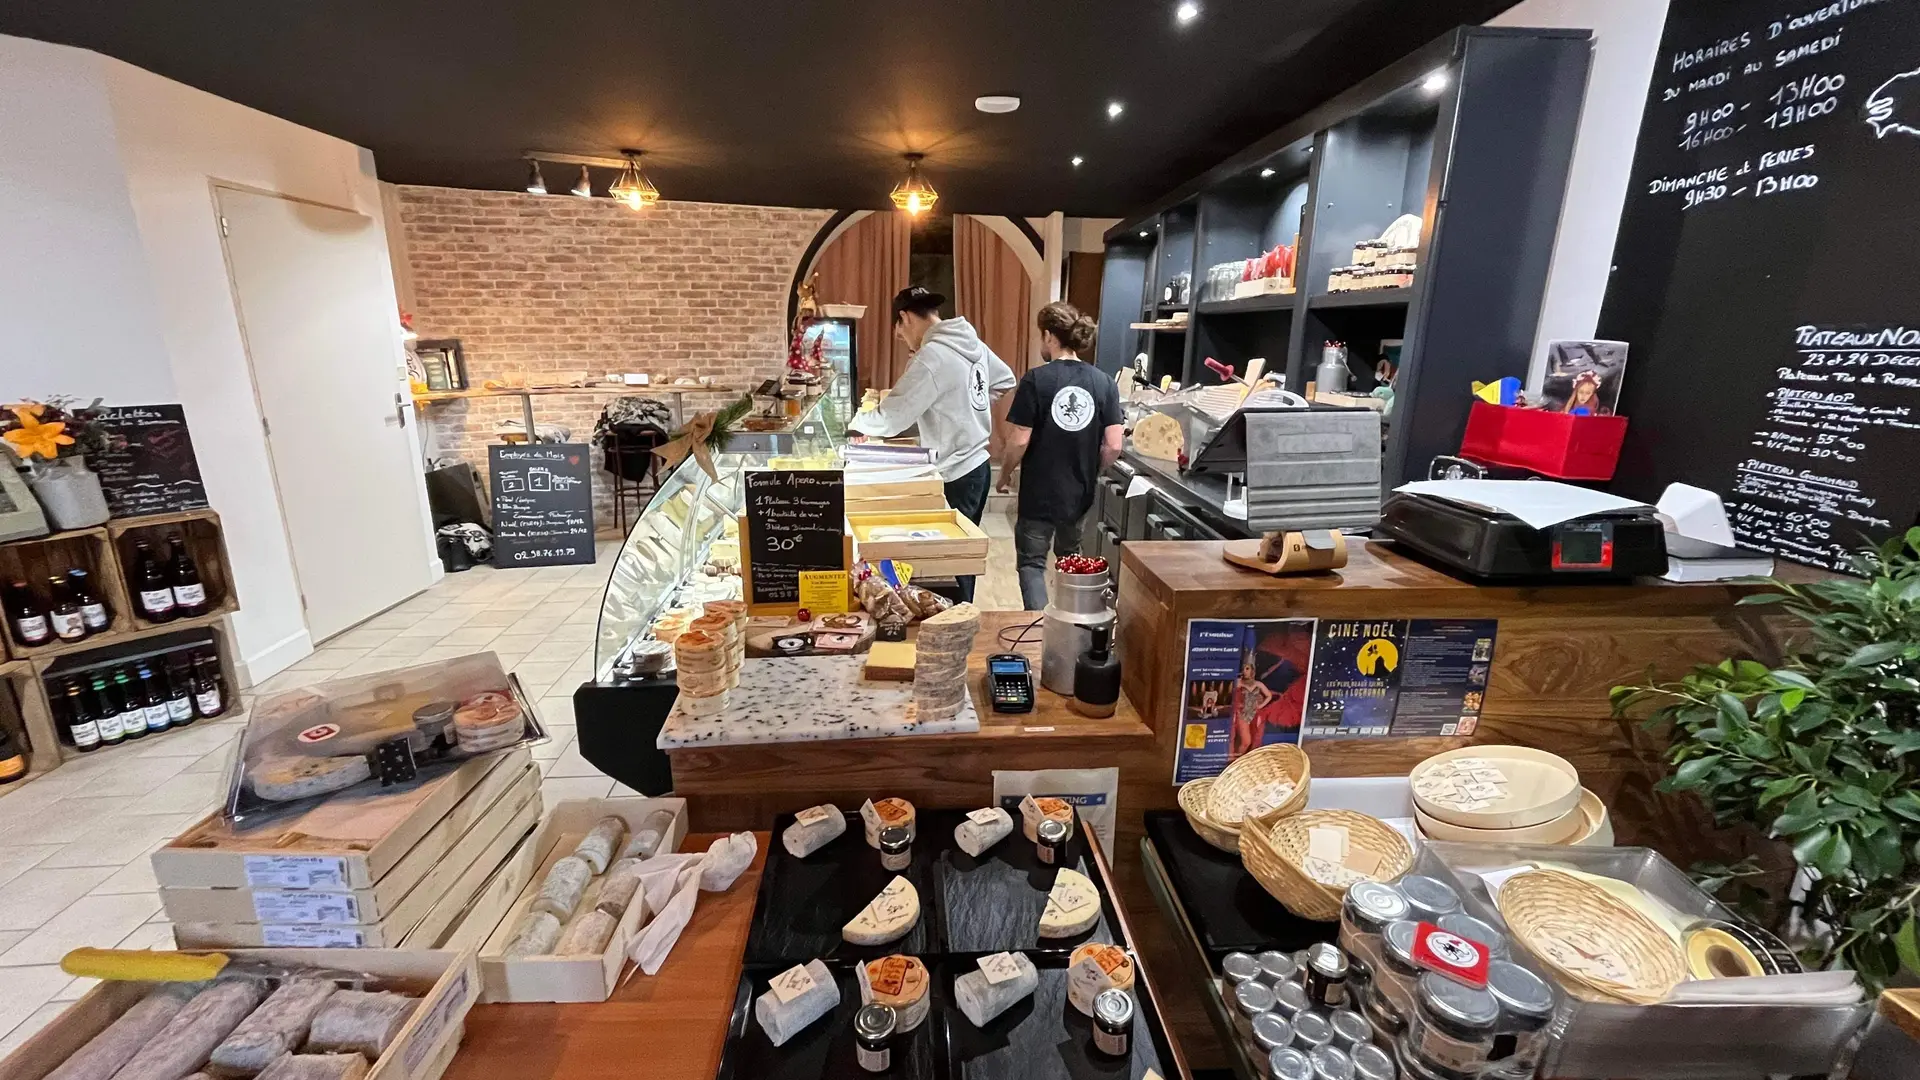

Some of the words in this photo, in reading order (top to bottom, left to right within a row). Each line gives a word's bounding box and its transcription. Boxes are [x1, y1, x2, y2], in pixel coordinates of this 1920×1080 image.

[1767, 0, 1877, 40] D'OUVERTU
[1743, 62, 1763, 76] AU
[1683, 102, 1735, 135] 9H00
[1769, 73, 1846, 106] 13H00
[1678, 126, 1735, 151] 16H00
[1763, 97, 1837, 129] 19H00
[1682, 185, 1727, 210] 9H30
[1755, 174, 1818, 197] 13H00
[1802, 353, 1825, 366] 23
[1843, 352, 1869, 366] 24
[1825, 392, 1855, 402] AOP
[97, 408, 162, 421] aclettes
[534, 477, 543, 487] 1
[1328, 621, 1360, 638] CINÉ
[1363, 621, 1397, 638] NOËL
[1064, 796, 1088, 804] TING
